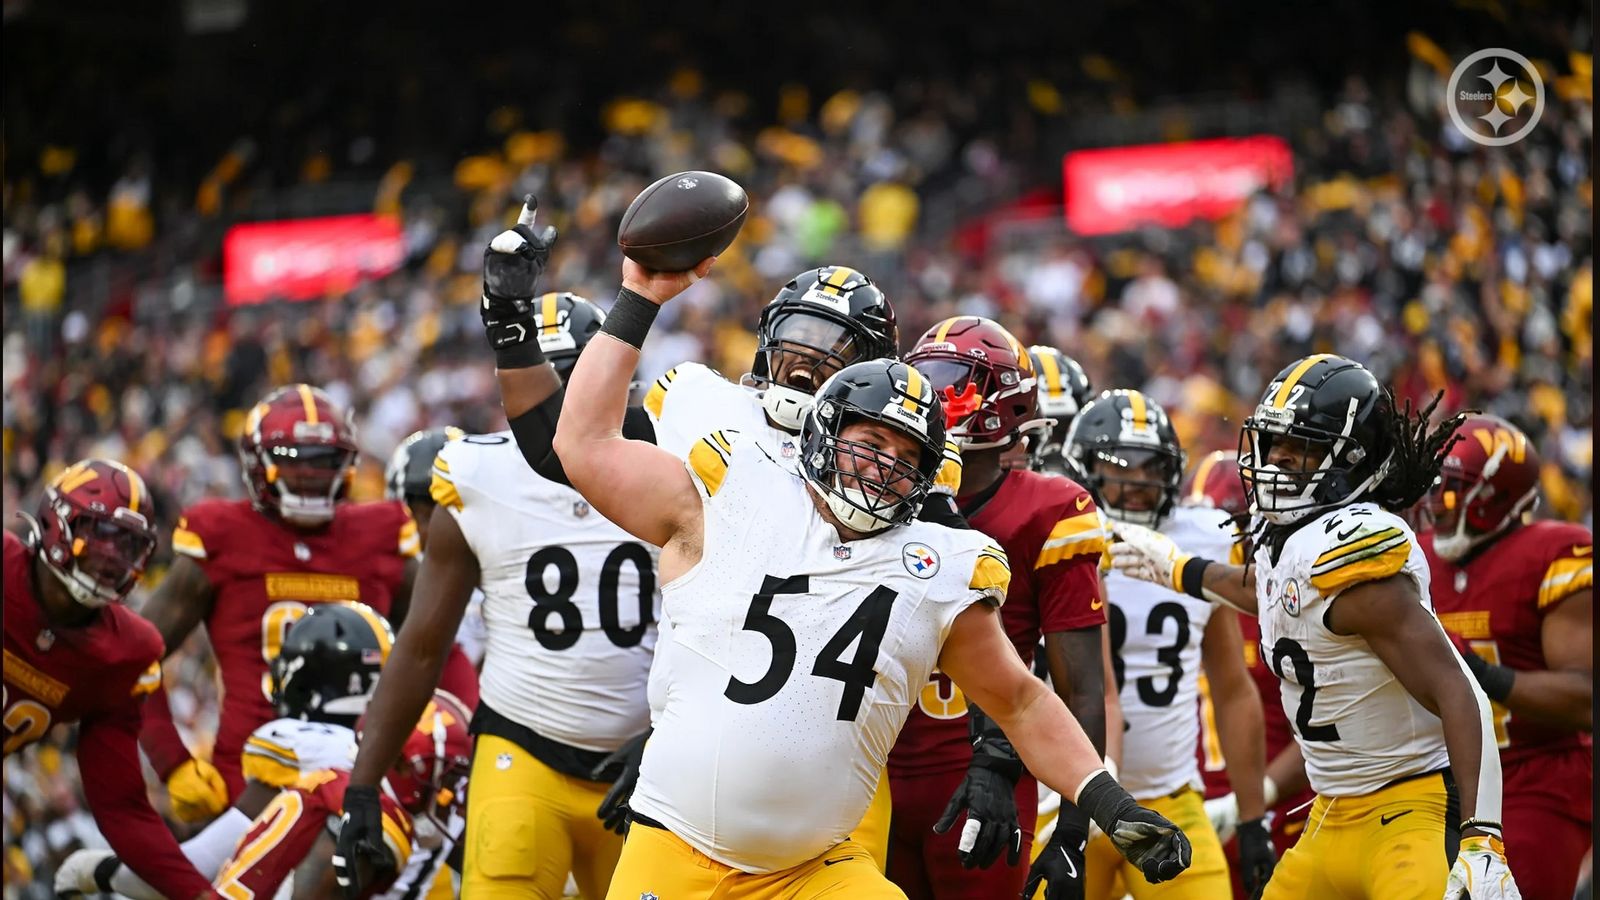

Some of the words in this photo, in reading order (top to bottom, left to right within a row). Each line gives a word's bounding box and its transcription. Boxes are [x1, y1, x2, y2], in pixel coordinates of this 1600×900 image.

[816, 292, 839, 304] Steelers
[1264, 381, 1306, 410] 22
[896, 406, 919, 423] Steelers
[525, 542, 656, 651] 80
[724, 574, 899, 722] 54
